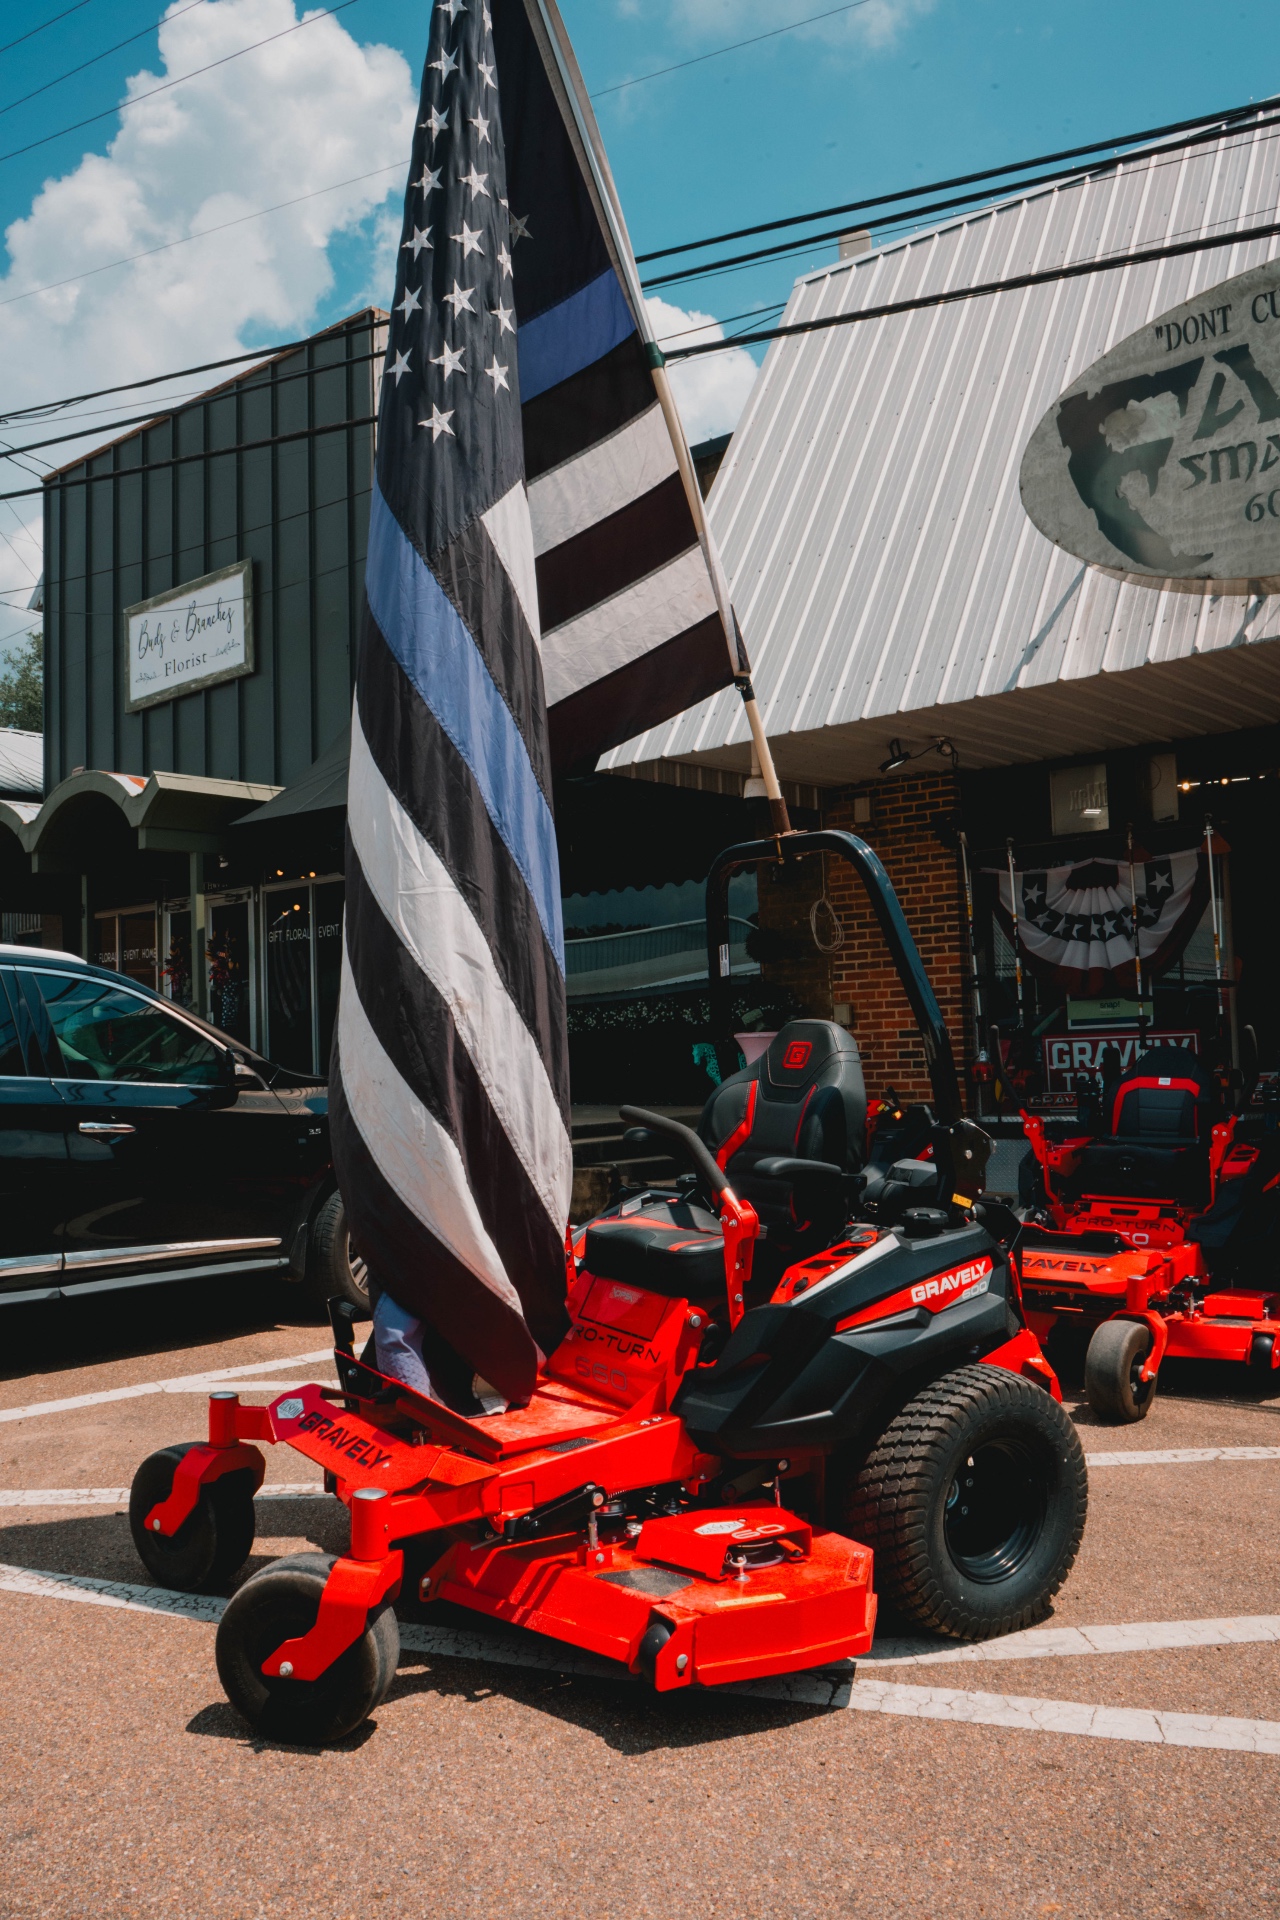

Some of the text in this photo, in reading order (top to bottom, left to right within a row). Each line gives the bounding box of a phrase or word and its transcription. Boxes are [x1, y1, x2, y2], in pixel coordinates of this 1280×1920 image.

[164, 652, 207, 677] Florist
[1099, 1000, 1120, 1009] snap!
[1075, 1217, 1176, 1232] PRO-TURN
[1022, 1257, 1107, 1274] RAVELY
[911, 1260, 986, 1303] GRAVELY
[962, 1281, 987, 1300] 600
[572, 1324, 661, 1363] RO-TURN
[575, 1356, 627, 1391] 660
[298, 1411, 392, 1470] GRAVELY
[731, 1524, 785, 1540] 60
